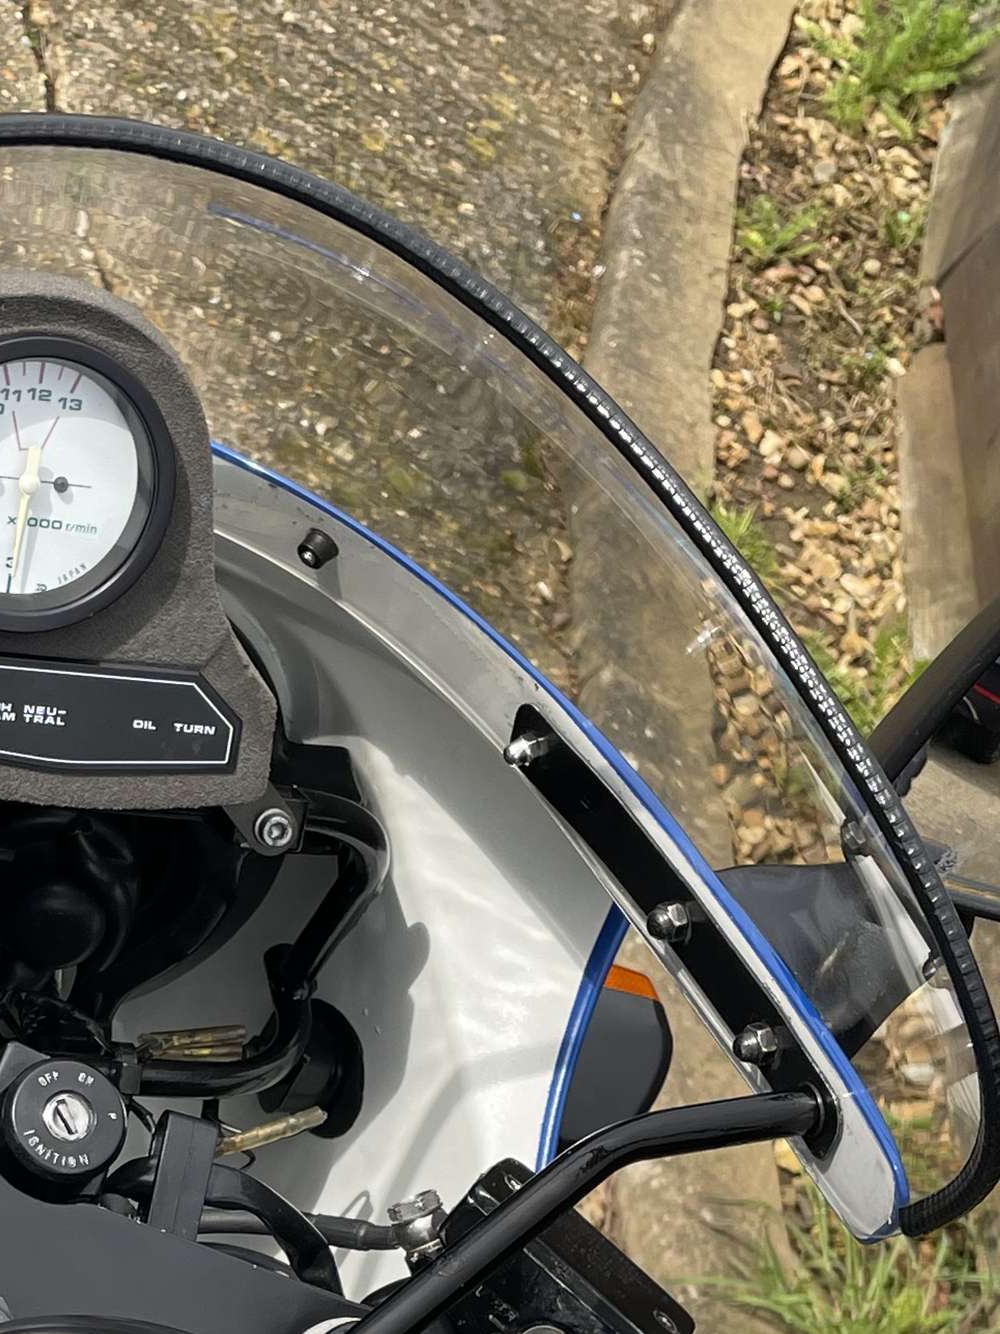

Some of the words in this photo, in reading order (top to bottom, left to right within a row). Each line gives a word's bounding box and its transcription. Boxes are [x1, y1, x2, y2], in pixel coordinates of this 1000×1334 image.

[0, 387, 22, 402] 11
[27, 387, 52, 402] 12
[58, 396, 83, 412] 13
[58, 563, 88, 585] JAPAN
[23, 705, 67, 716] NEU-
[23, 713, 66, 726] TRAL
[132, 719, 157, 731] OIL
[173, 722, 216, 736] TURN
[38, 1070, 59, 1086] OFF
[23, 1129, 89, 1168] IGNITION
